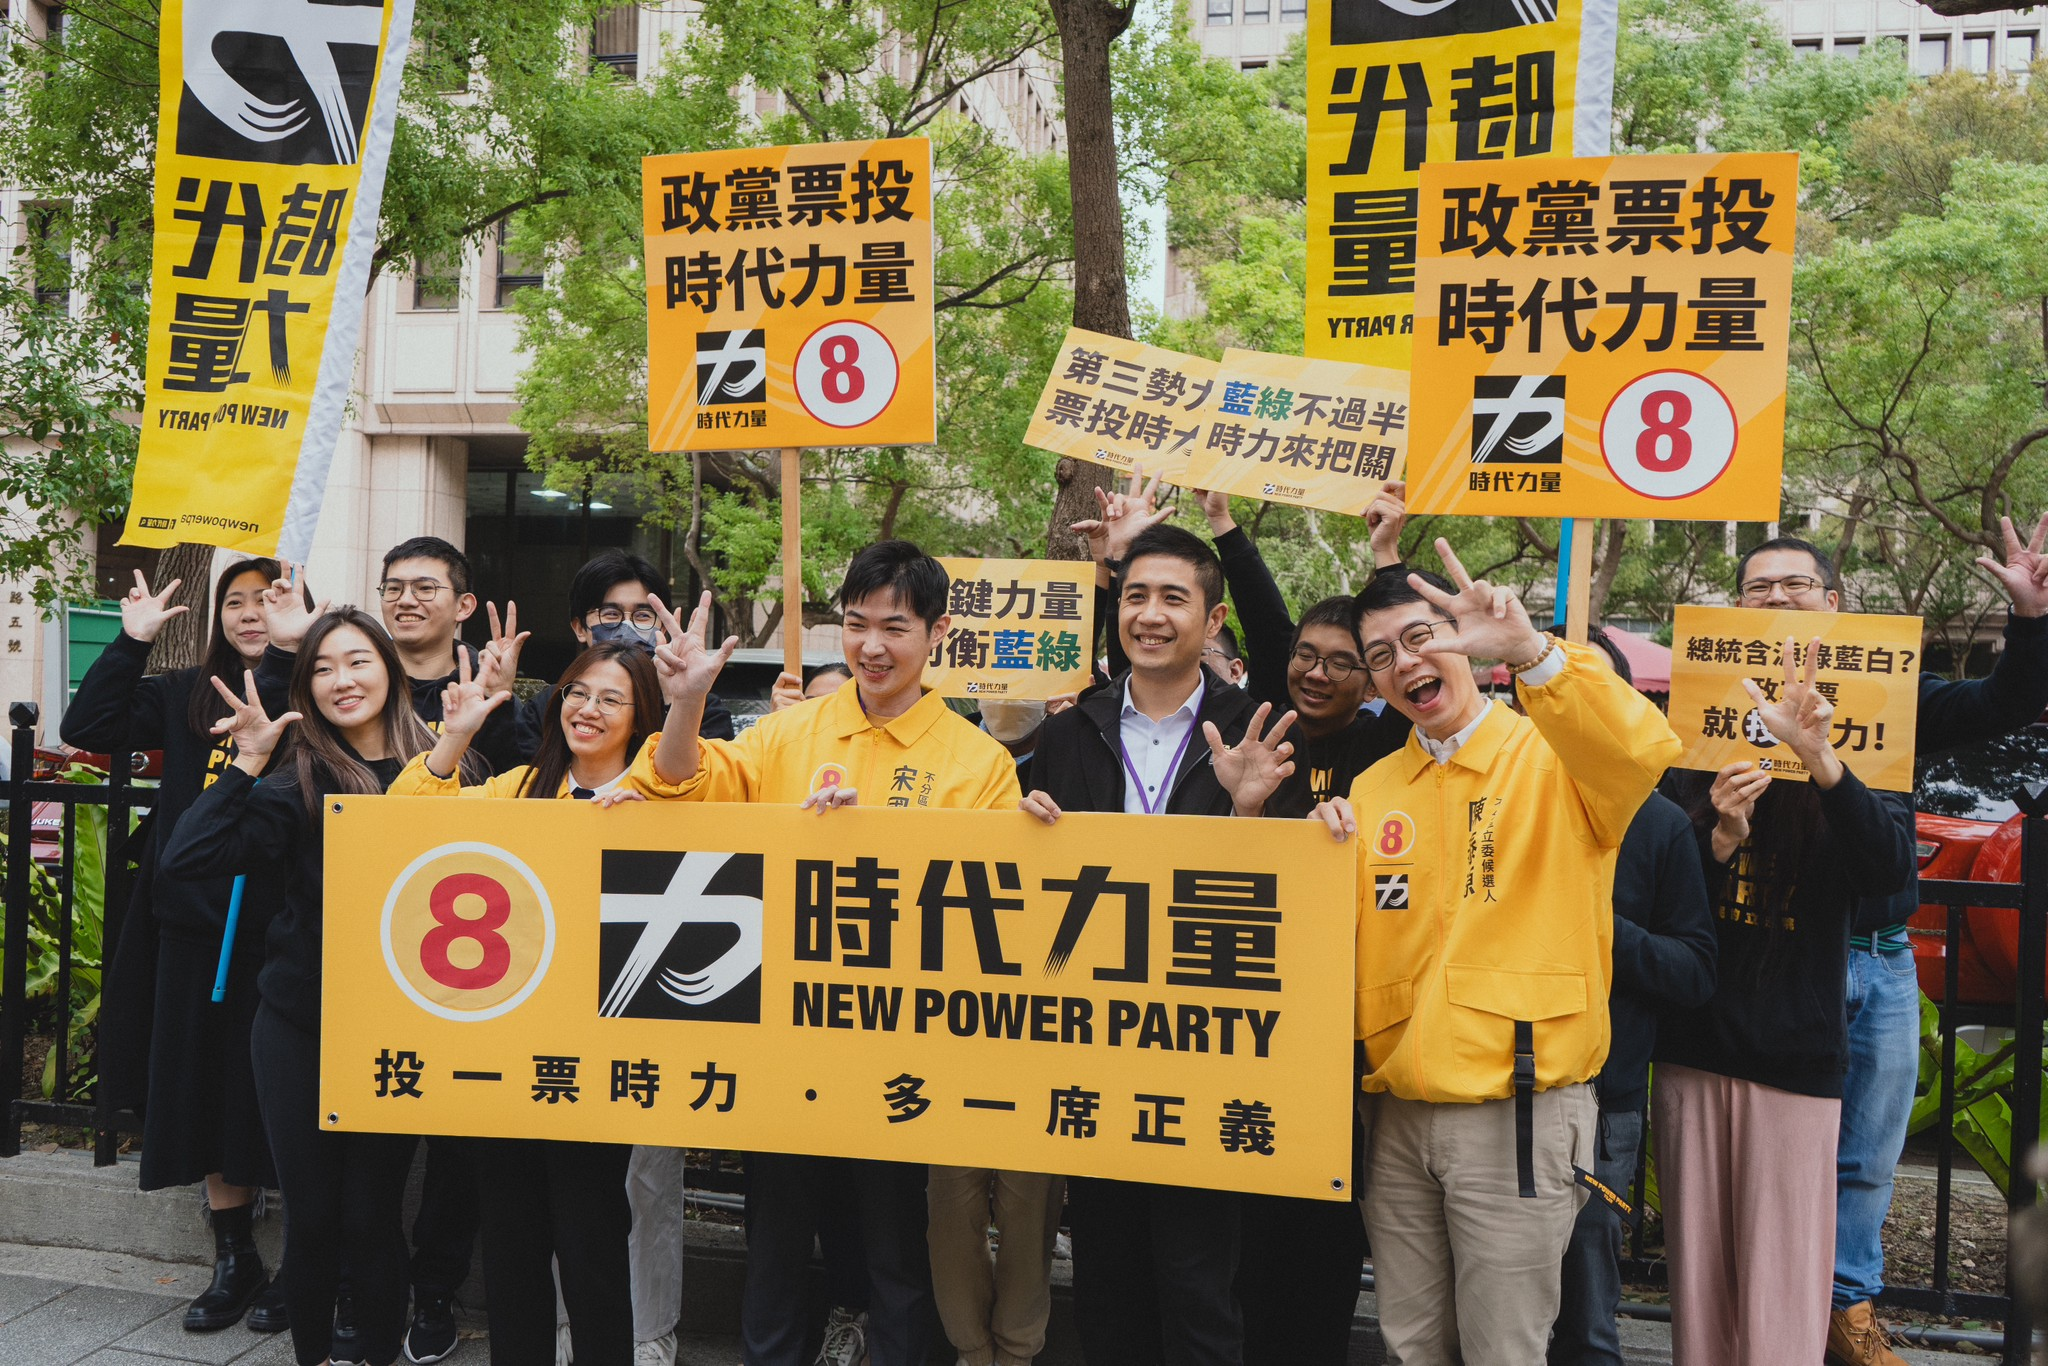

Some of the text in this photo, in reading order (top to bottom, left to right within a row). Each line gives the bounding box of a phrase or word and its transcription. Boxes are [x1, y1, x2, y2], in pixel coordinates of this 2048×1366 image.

[661, 159, 914, 234] 政黨票投
[1439, 177, 1775, 259] 政黨票投
[665, 241, 915, 314] 時代力量
[1438, 276, 1767, 354] 時代力量
[819, 335, 866, 404] 8
[696, 409, 767, 429] 時代力量
[1218, 380, 1408, 436] 藍綠不過半
[1635, 389, 1692, 472] 8
[1206, 421, 1396, 481] 時力來把關
[1469, 471, 1561, 494] 時代力量
[949, 578, 1083, 621] 鍵力量
[929, 627, 1081, 672] 衡藍綠
[1751, 677, 1840, 709] 政票
[1380, 820, 1403, 855] 8
[420, 872, 512, 990] 8
[794, 857, 1282, 992] 時代力量
[793, 981, 1282, 1059] NEW POWER PARTY
[1616, 1196, 1633, 1215] PARTY
